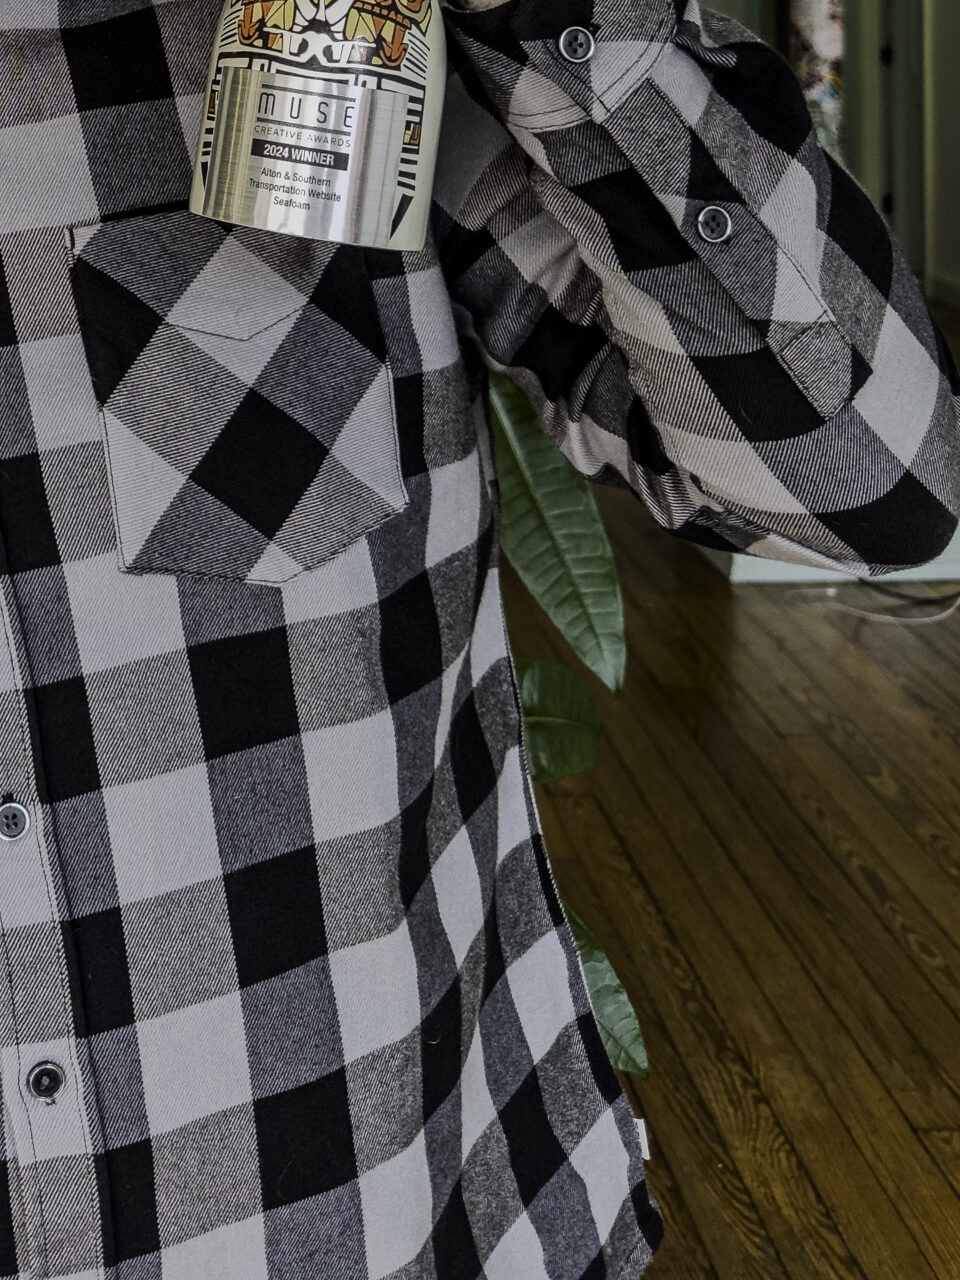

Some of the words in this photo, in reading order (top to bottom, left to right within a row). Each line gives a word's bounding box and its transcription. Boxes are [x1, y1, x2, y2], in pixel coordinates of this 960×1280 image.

[257, 91, 356, 128] MUSE
[254, 125, 302, 140] CREATIVE
[307, 133, 351, 148] AWARDS
[263, 144, 289, 159] 2024
[291, 148, 335, 166] WINNER
[260, 166, 282, 179] Alton
[284, 170, 290, 180] &
[292, 171, 331, 187] Southern
[249, 178, 306, 197] Transportation
[308, 187, 342, 202] Website
[273, 195, 311, 211] Seafoam
